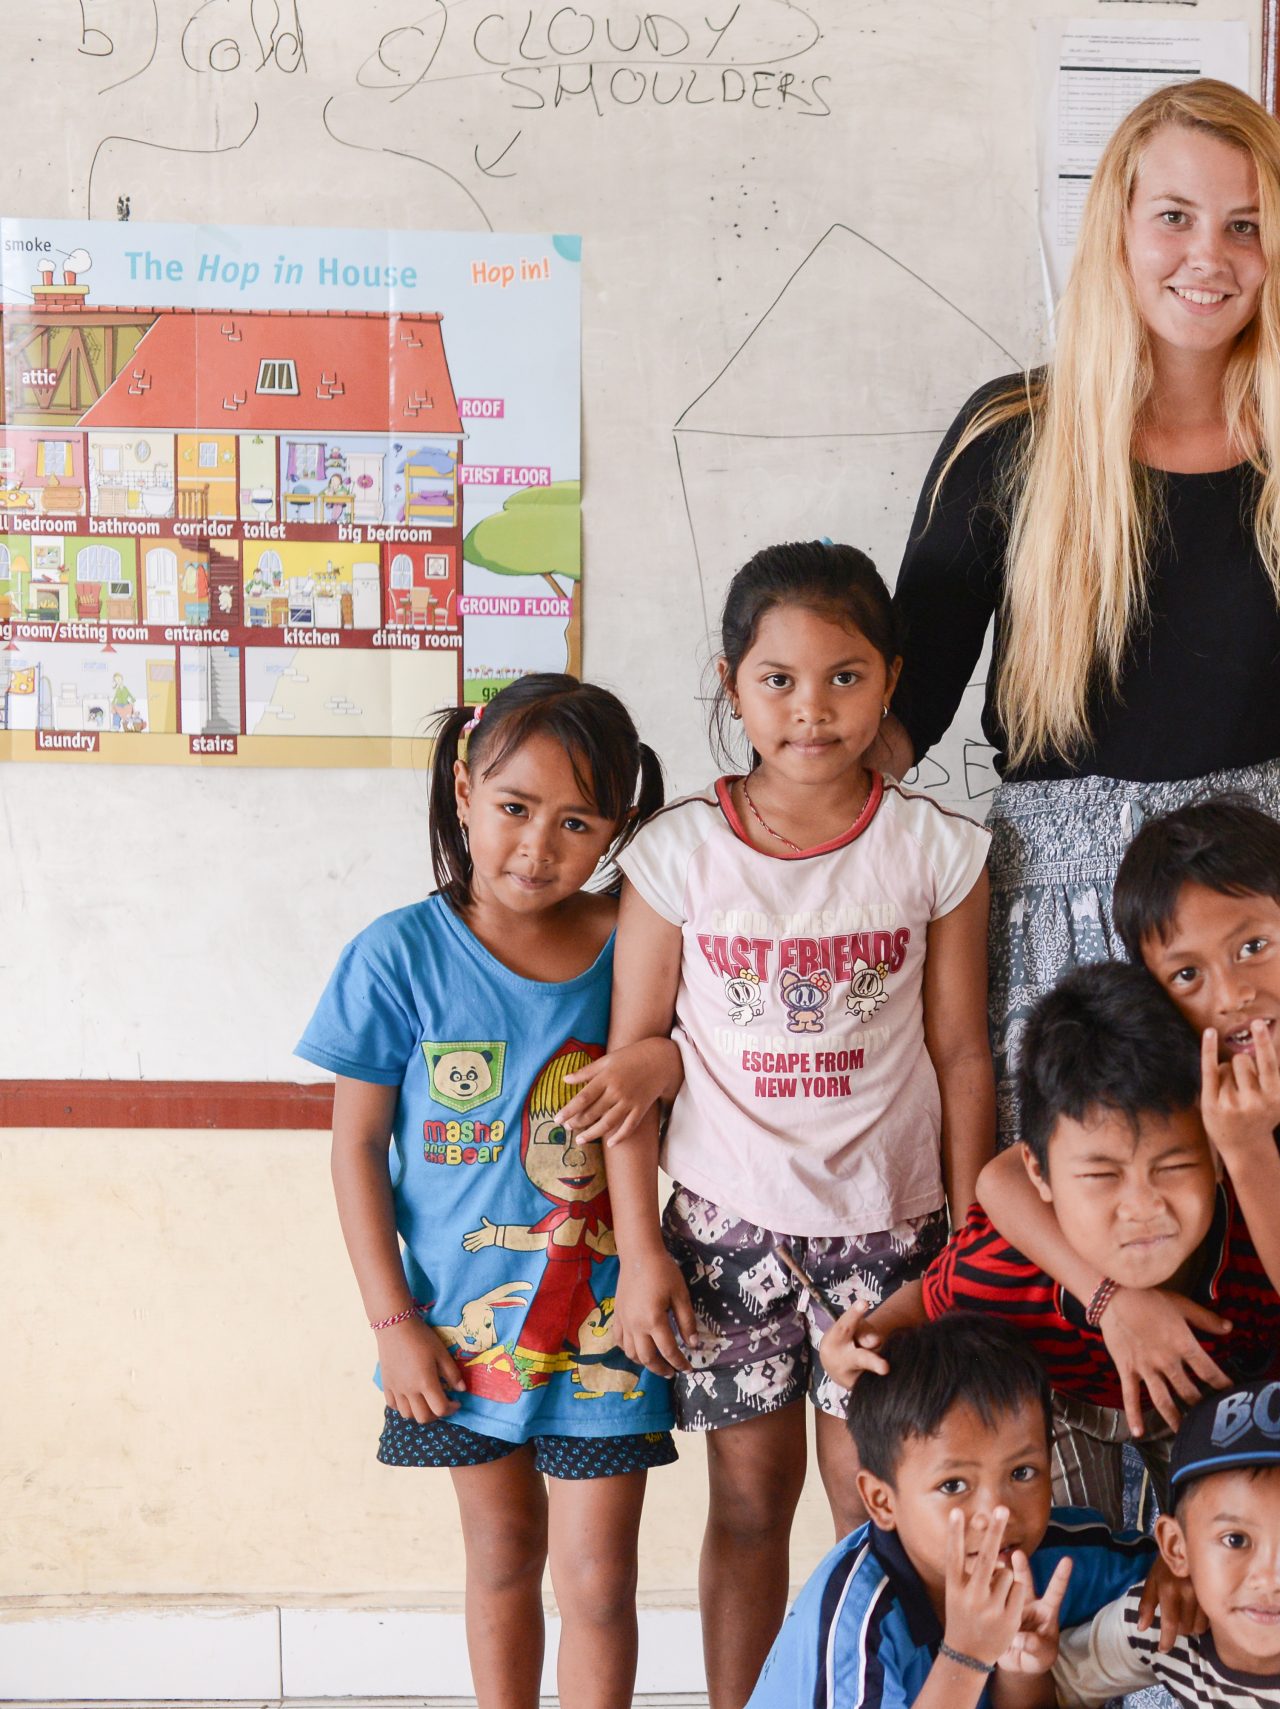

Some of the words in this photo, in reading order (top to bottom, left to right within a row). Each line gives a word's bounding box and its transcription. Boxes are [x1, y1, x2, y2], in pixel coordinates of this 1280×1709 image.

[474, 5, 741, 65] CLOUDY
[501, 64, 832, 116] SHOULDERS
[4, 237, 52, 254] smoke
[124, 251, 184, 282] The
[197, 252, 260, 291] Hop
[273, 255, 303, 286] in
[318, 258, 418, 289] House
[471, 259, 515, 289] Hop
[521, 256, 550, 283] in!
[22, 368, 57, 388] attic
[462, 400, 501, 416] ROOF
[461, 467, 499, 484] FIRST
[503, 468, 549, 485] FLOOR
[14, 515, 77, 532] bedroom
[89, 517, 160, 535] bathroom
[173, 519, 233, 538] corridor
[243, 522, 286, 540] toilet
[338, 523, 363, 546] big
[367, 524, 432, 542] bedroom
[460, 599, 518, 615] GROUND
[523, 599, 569, 616] FLOOR
[16, 622, 107, 642] room/sitting
[112, 627, 148, 640] room
[164, 627, 229, 642] entrance
[283, 627, 340, 647] kitchen
[372, 631, 421, 651] dining
[425, 633, 463, 649] room
[39, 731, 96, 752] laundry
[192, 736, 234, 752] stairs
[697, 933, 774, 983] FAST
[779, 927, 911, 984] FRIENDS
[742, 1049, 810, 1074] ESCAPE
[815, 1049, 865, 1072] FROM
[755, 1076, 797, 1098] NEW
[802, 1075, 852, 1098] YORK
[424, 1120, 505, 1143] masha
[424, 1142, 445, 1154] and
[425, 1152, 446, 1164] the
[446, 1145, 504, 1165] Bear
